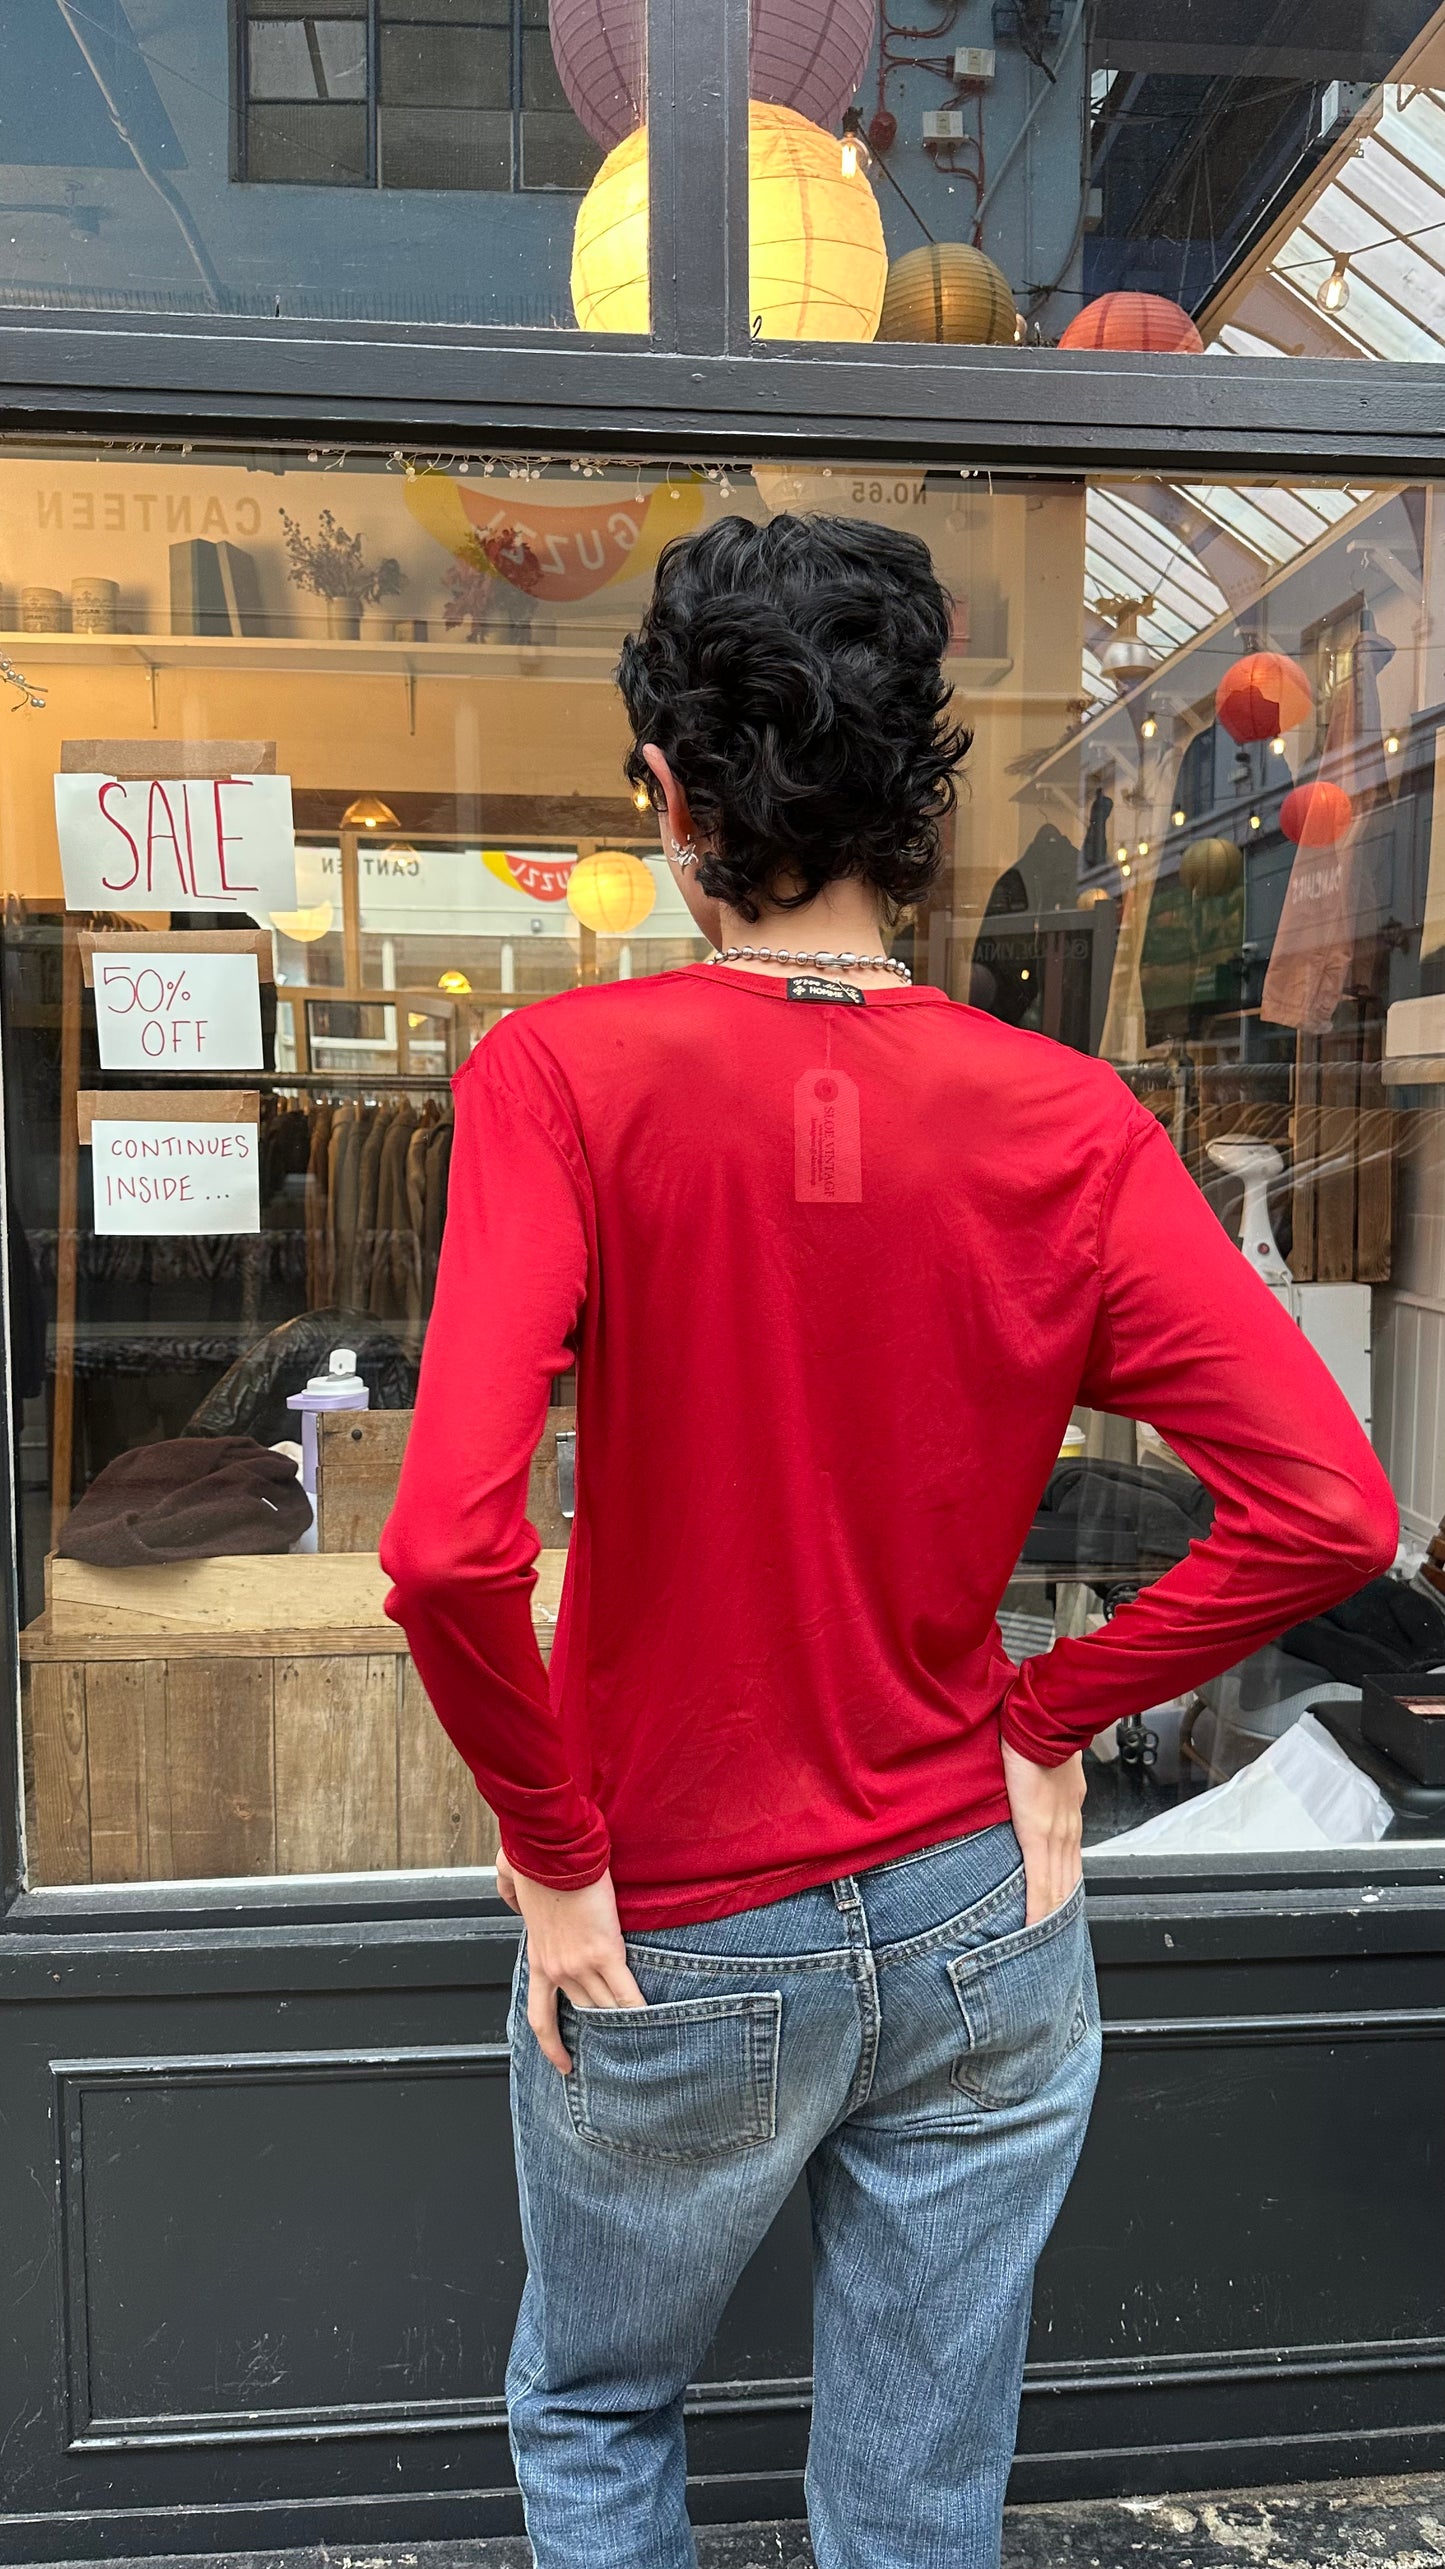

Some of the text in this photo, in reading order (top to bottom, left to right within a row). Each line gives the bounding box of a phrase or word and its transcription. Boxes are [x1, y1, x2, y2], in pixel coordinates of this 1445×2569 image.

[98, 780, 259, 900] SALE
[103, 966, 191, 1014] 50%
[809, 986, 844, 998] HOMME
[141, 1020, 208, 1057] OFF
[111, 1134, 249, 1158] CONTINUES
